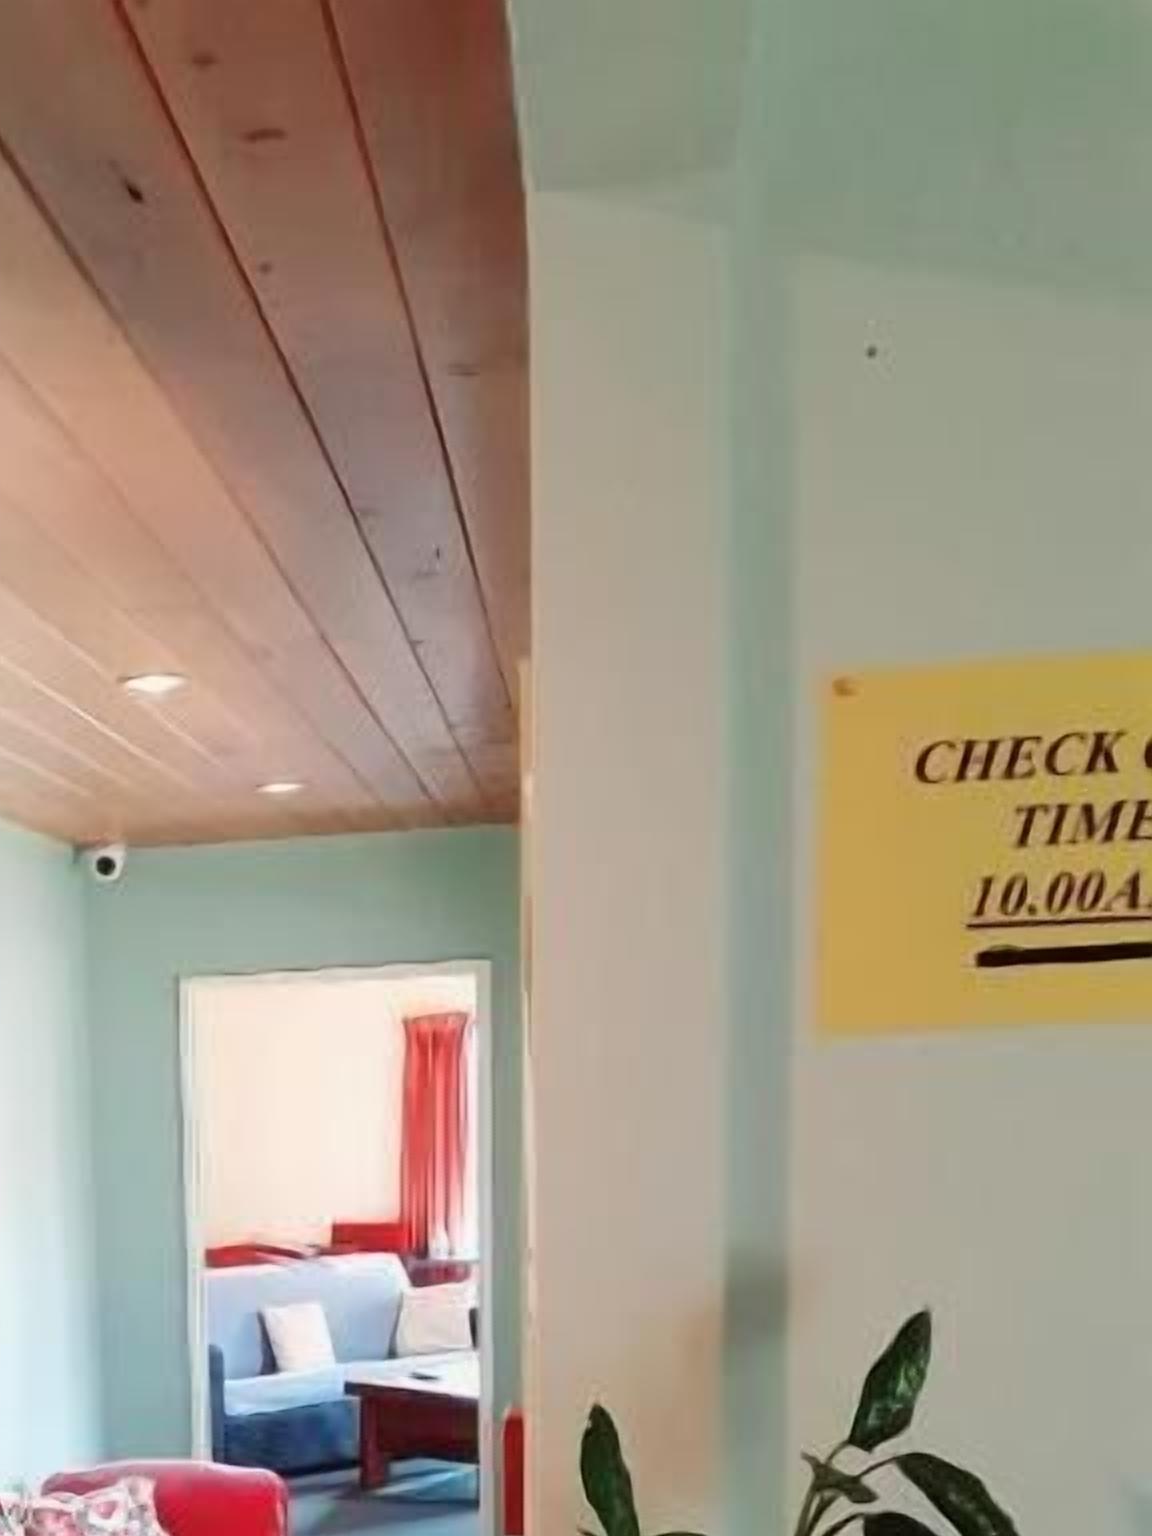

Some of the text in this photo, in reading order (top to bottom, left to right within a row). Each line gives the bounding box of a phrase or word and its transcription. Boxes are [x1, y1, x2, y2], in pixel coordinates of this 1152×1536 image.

[914, 729, 1127, 784] CHECK
[1013, 799, 1152, 848] TIME
[971, 869, 1152, 918] 10.00A
